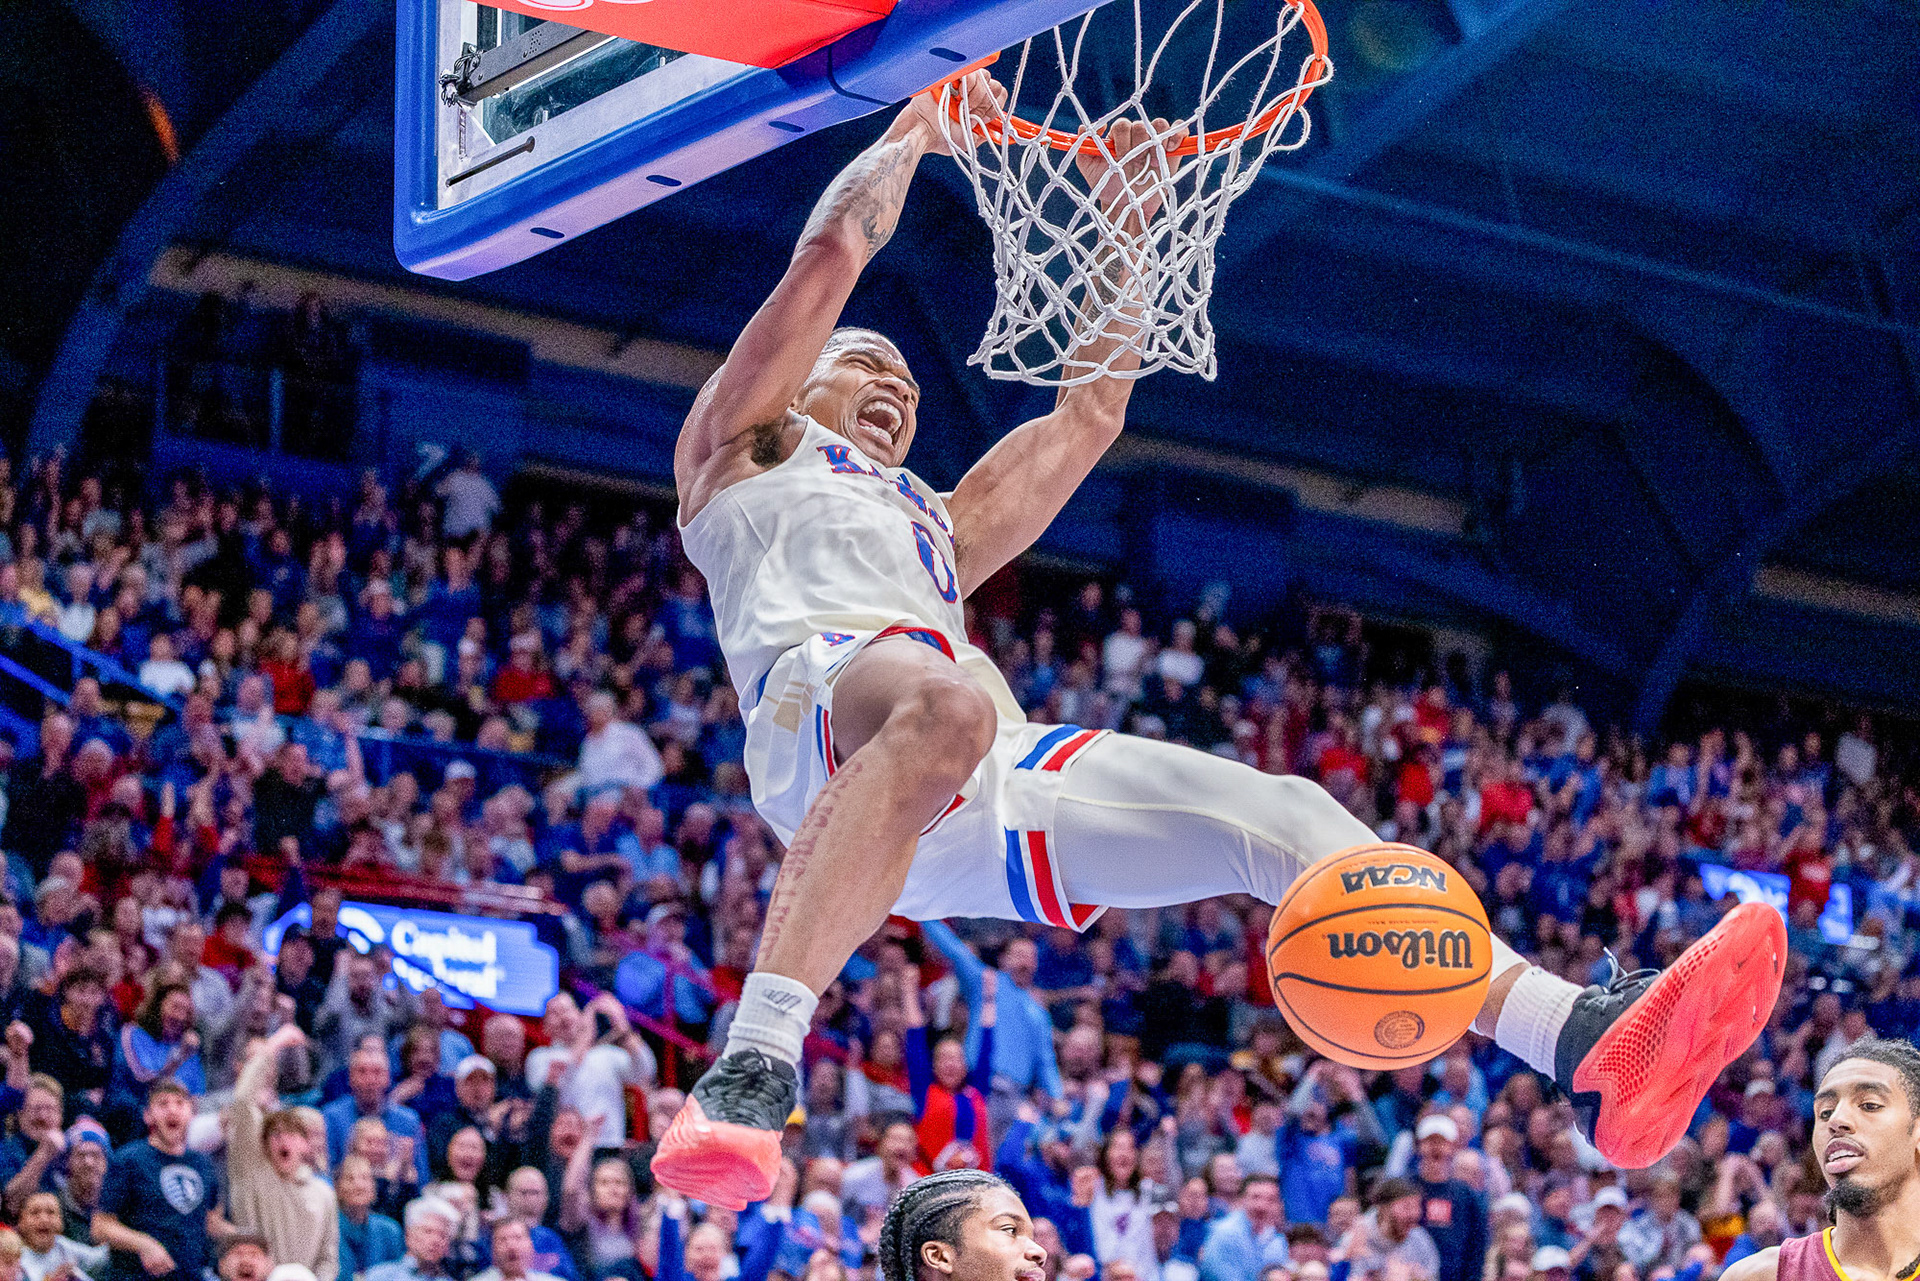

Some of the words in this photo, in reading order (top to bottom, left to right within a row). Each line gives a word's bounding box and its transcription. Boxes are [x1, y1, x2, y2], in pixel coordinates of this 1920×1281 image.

[911, 521, 958, 604] 0
[1340, 864, 1448, 895] NCAA
[1327, 929, 1474, 970] Wilson
